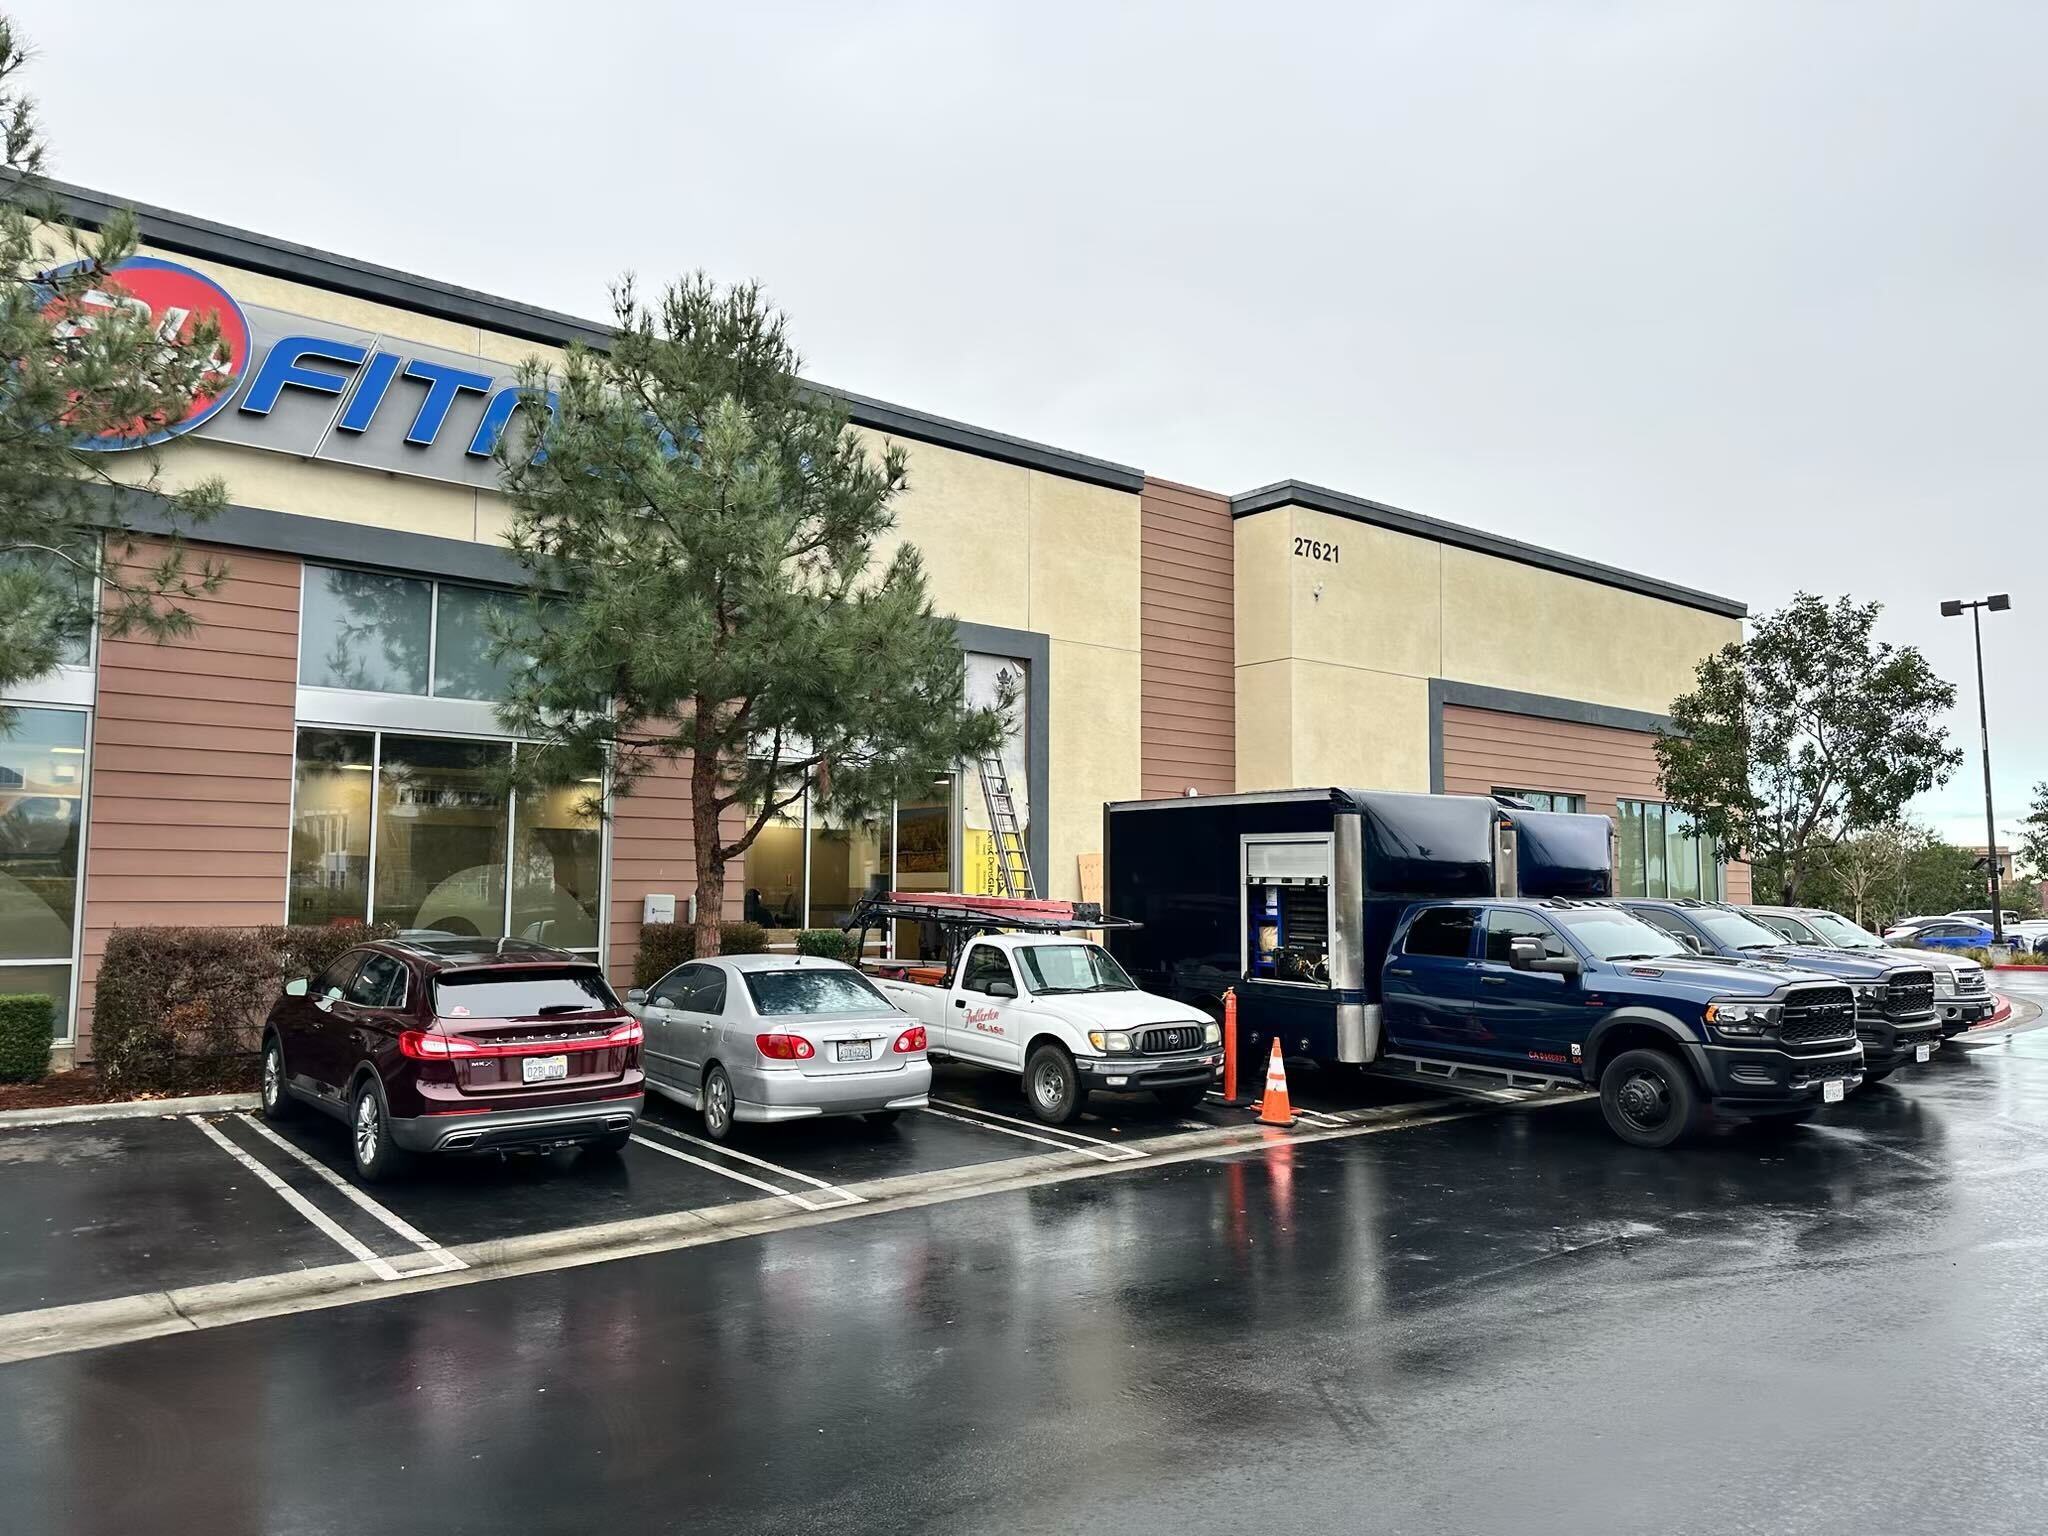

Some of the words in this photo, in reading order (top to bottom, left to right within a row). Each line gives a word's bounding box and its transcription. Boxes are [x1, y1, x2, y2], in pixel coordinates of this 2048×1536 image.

[1294, 537, 1338, 563] 27621
[496, 1030, 596, 1042] LINCOLN
[976, 1022, 1005, 1036] GLASS
